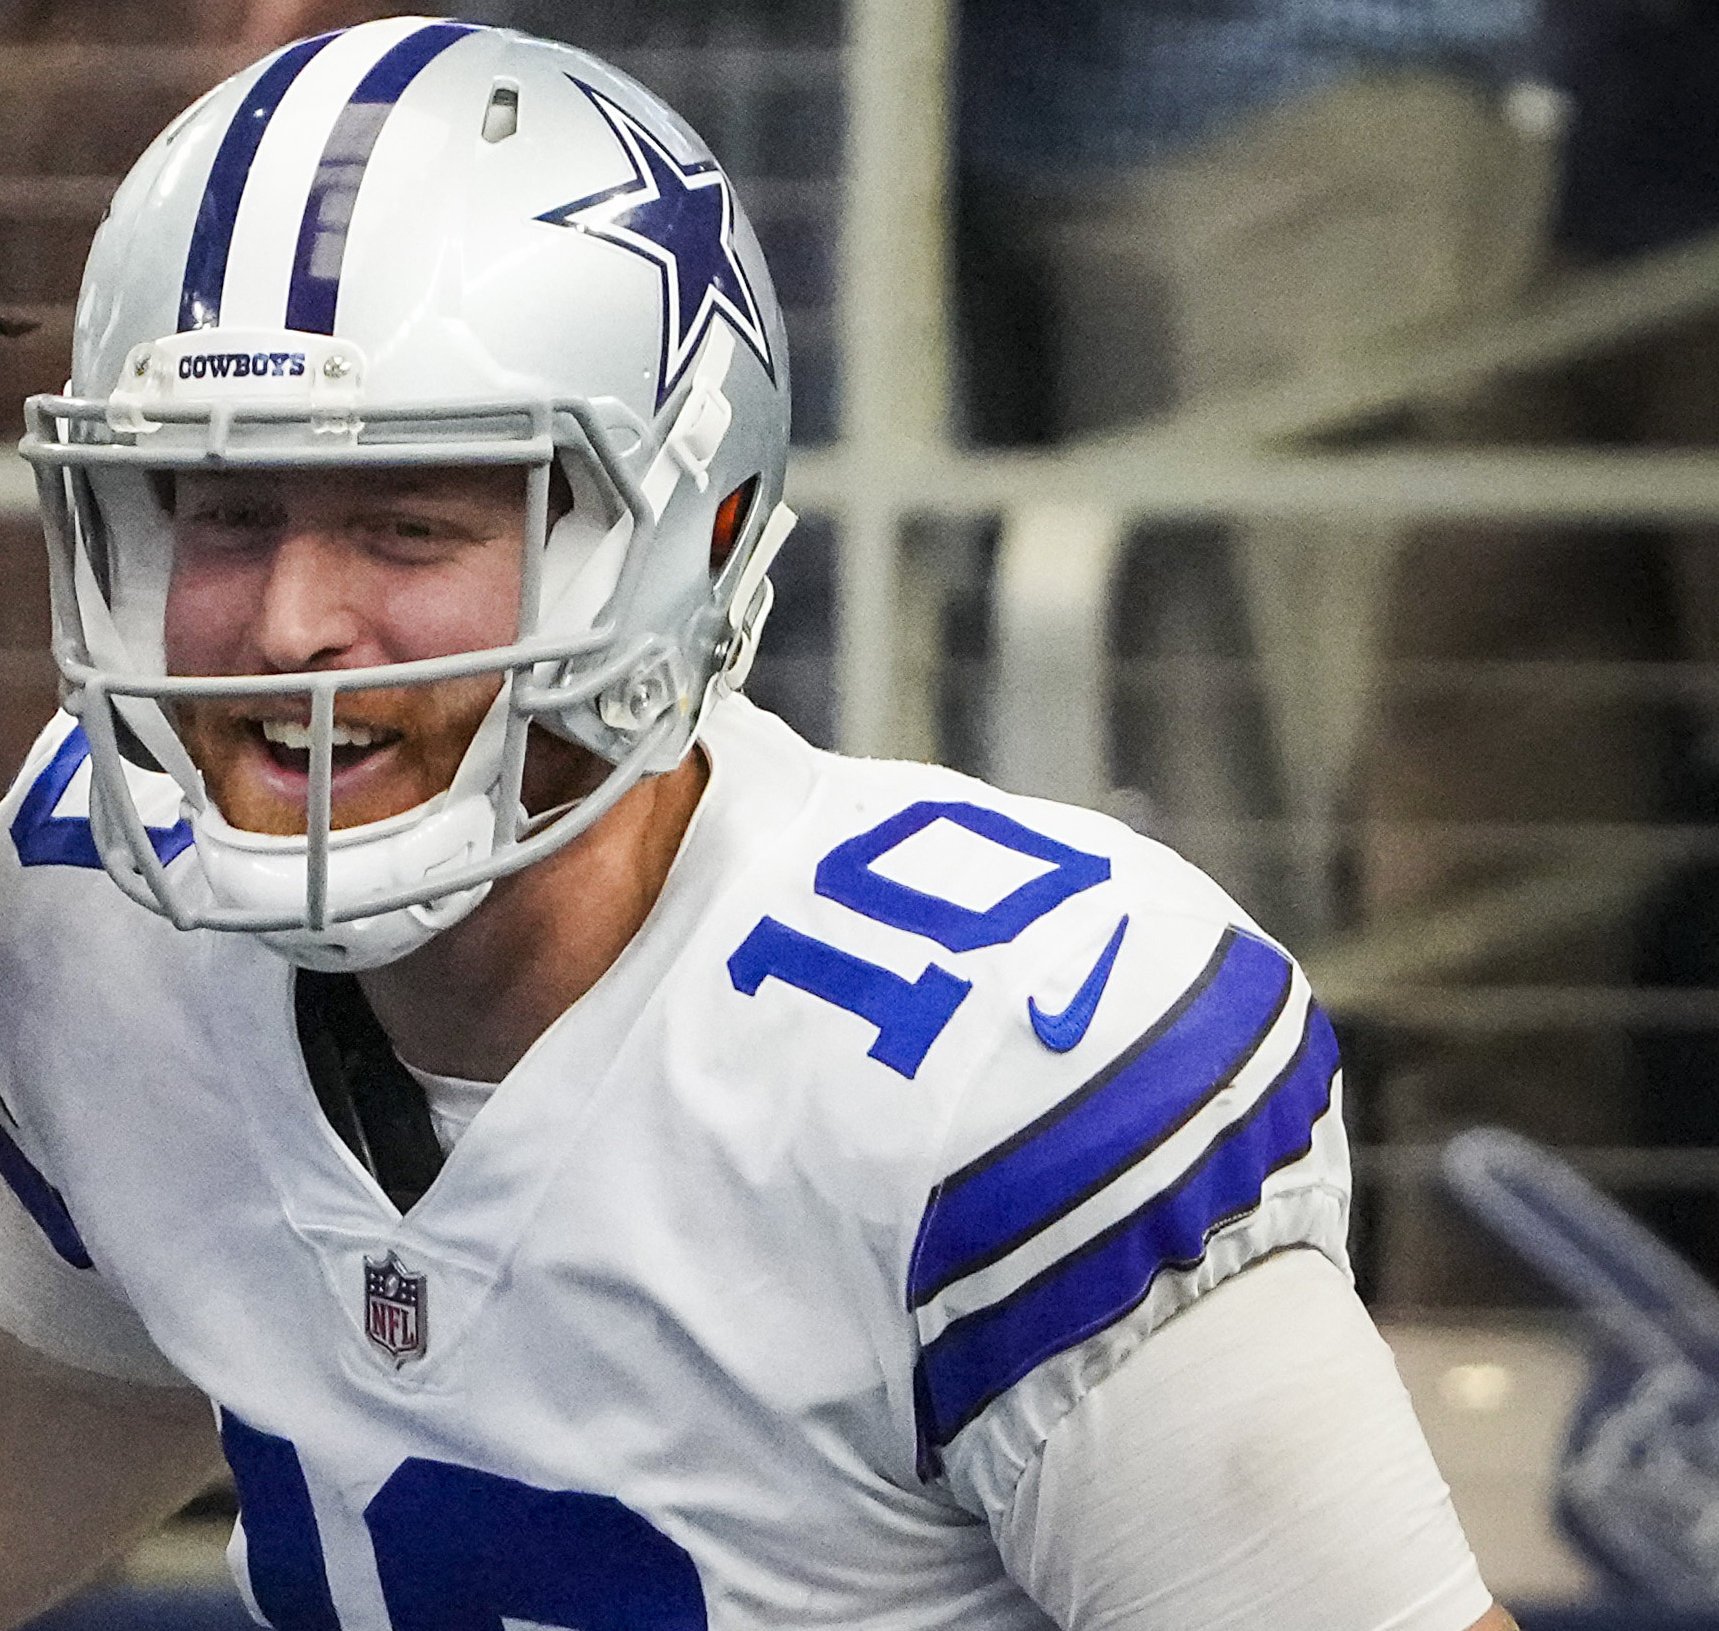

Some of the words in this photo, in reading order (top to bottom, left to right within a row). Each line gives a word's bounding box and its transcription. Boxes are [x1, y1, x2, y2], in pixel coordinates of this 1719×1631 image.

[178, 352, 306, 379] COWBOYS
[727, 801, 1111, 1080] 10
[372, 1302, 416, 1347] NFL
